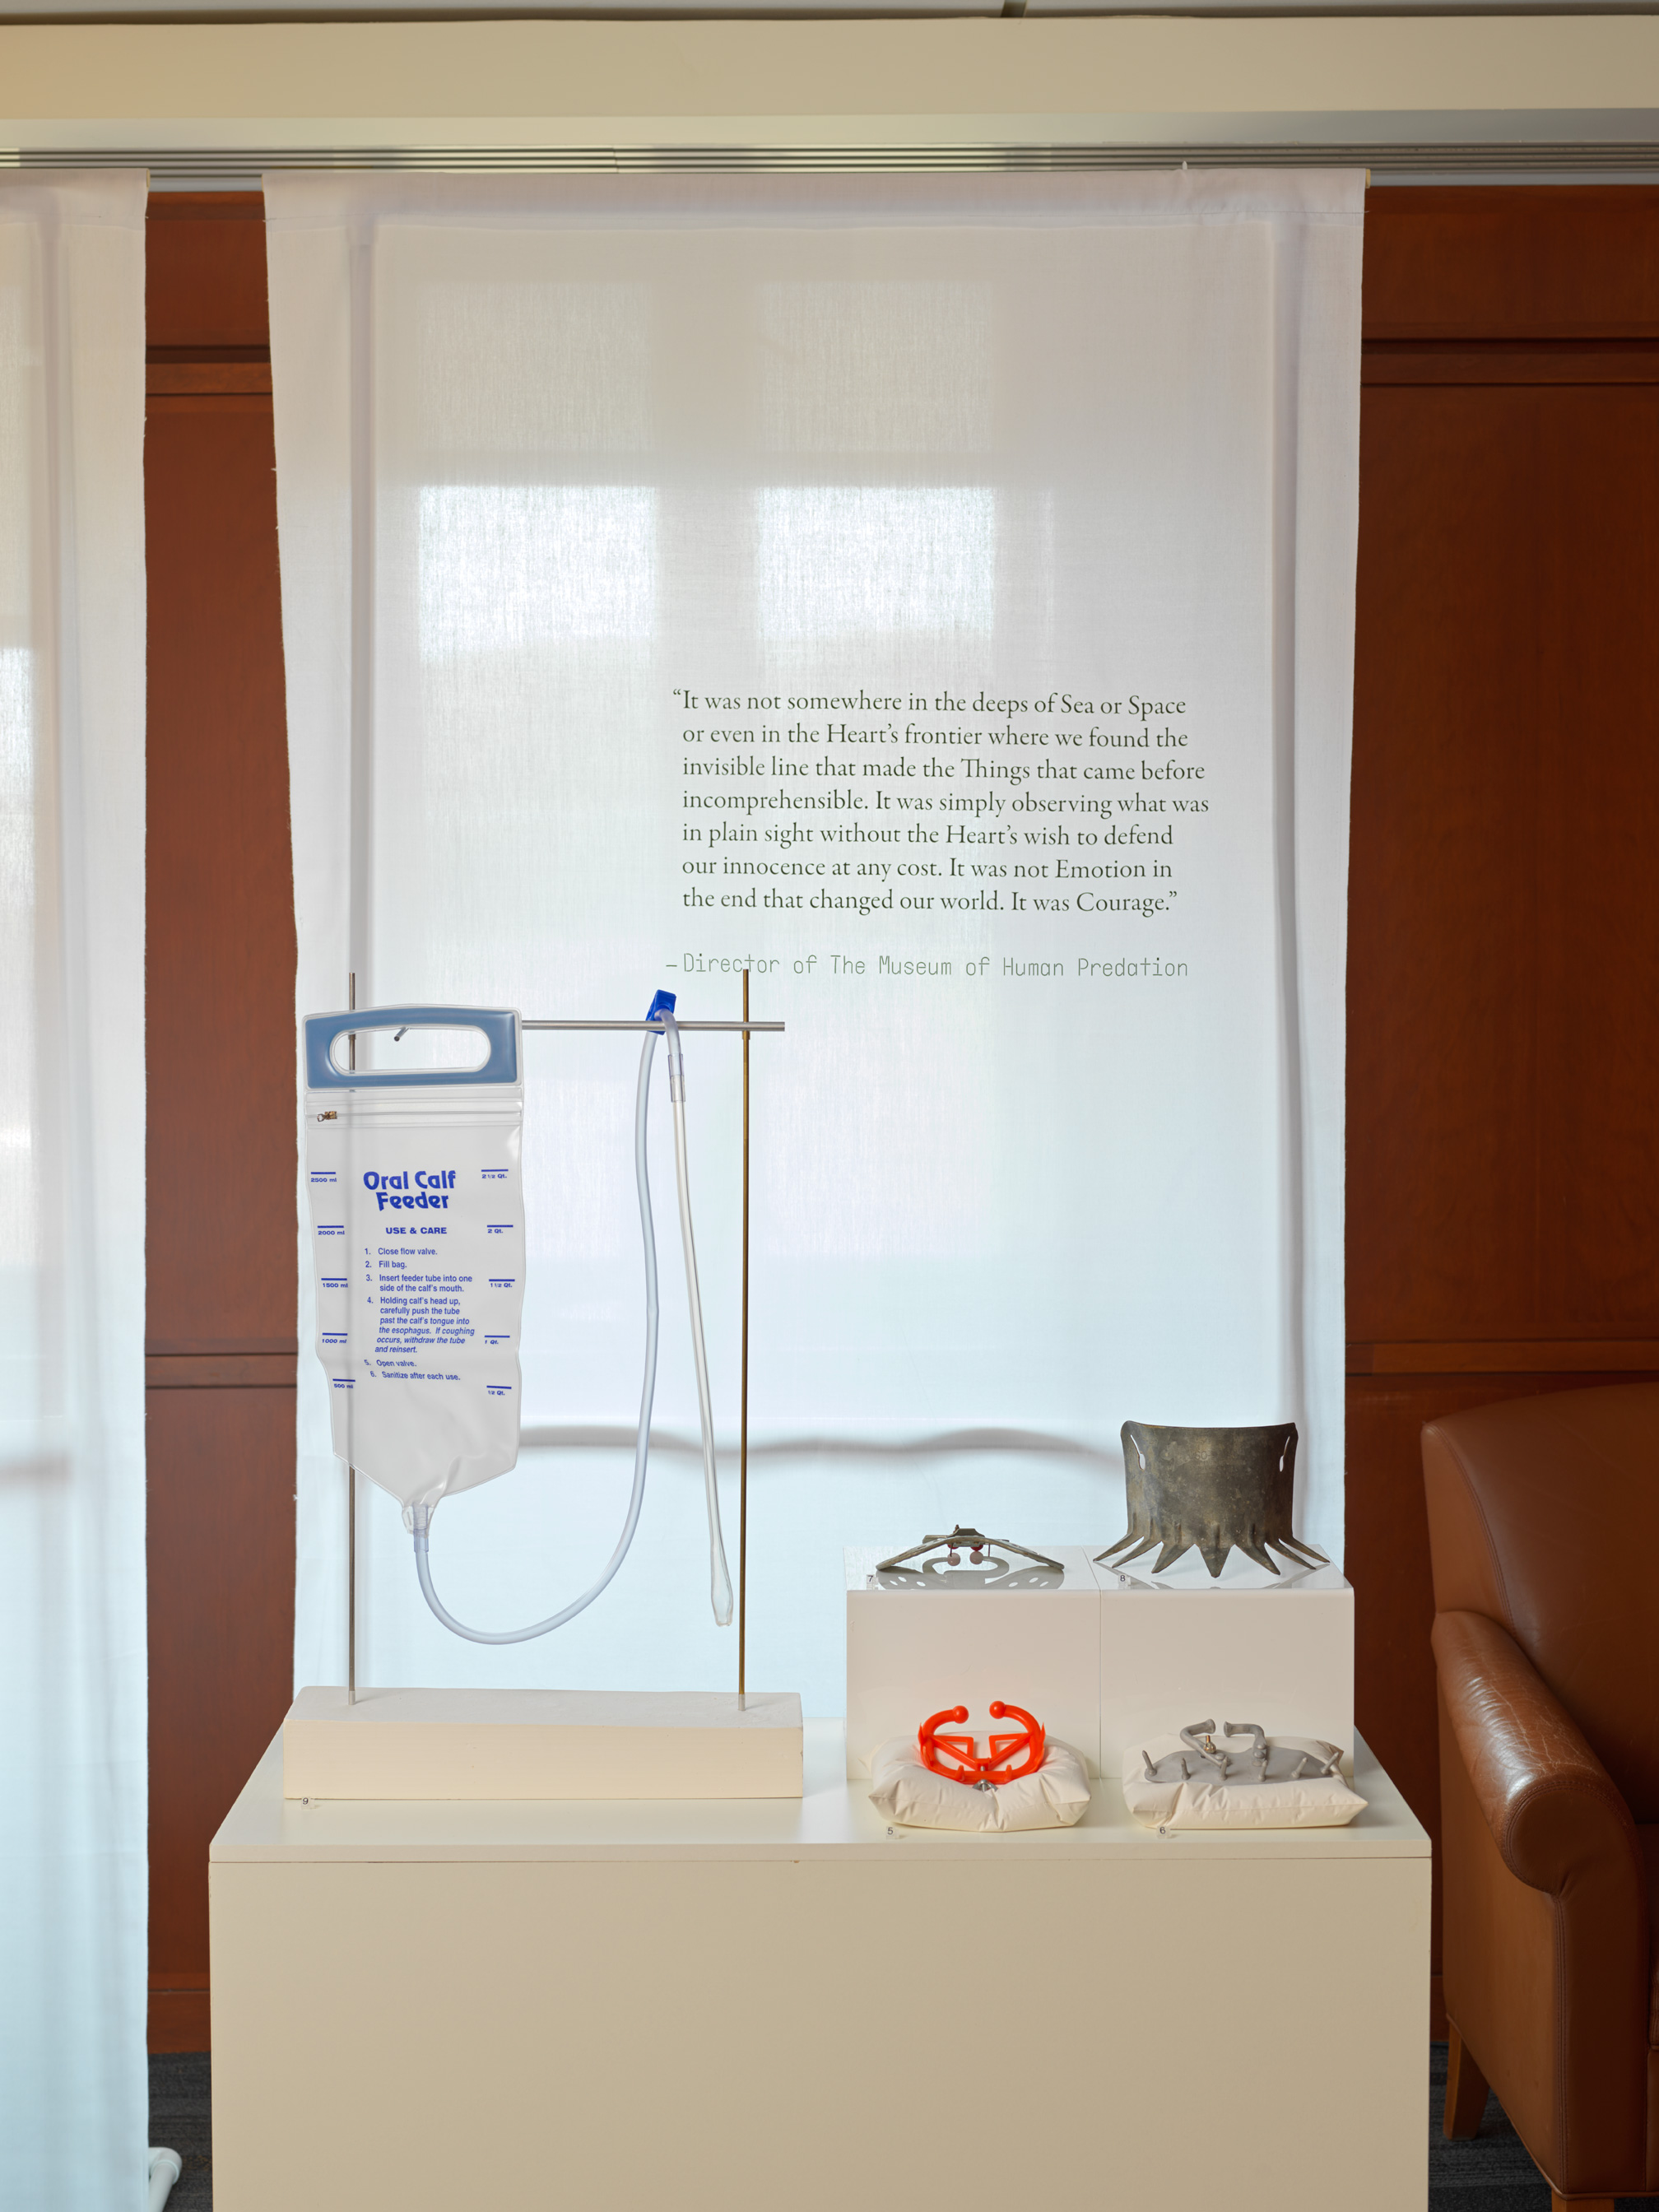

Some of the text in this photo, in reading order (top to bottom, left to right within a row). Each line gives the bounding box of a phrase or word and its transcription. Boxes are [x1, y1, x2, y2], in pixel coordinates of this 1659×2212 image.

[673, 689, 1186, 722] “It was not somewhere in the deeps of Sea or Space
[683, 723, 1187, 747] or even in the Heart’s frontier where we found the
[683, 755, 1205, 786] invisible line that made the Things that came before
[683, 788, 1209, 820] incomprehensible. It was simply observing what was
[683, 821, 1173, 849] in plain sight without the Heart’s wish to defend
[682, 857, 1172, 882] our innocence at any cost. It was not Emotion in
[683, 886, 1177, 918] the end that changed our world. It was Courage.”
[794, 955, 817, 974] of
[830, 955, 865, 974] The
[880, 955, 951, 975] Museum
[966, 956, 990, 976] of
[1004, 957, 1063, 976] Human
[1079, 957, 1187, 977] Predation
[363, 1170, 456, 1190] Oral Calf
[375, 1192, 449, 1211] Feeder
[392, 1261, 407, 1270] bag.
[402, 1274, 424, 1282] feeder
[443, 1274, 457, 1282] into
[380, 1297, 407, 1306] Holding
[380, 1307, 410, 1316] carefully
[411, 1307, 429, 1316] push
[392, 1327, 431, 1336] esophagus.
[442, 1327, 475, 1336] coughing
[430, 1317, 454, 1327] tongue
[867, 1574, 873, 1582] 7
[887, 1827, 894, 1835] 5
[1159, 1826, 1166, 1834] 6
